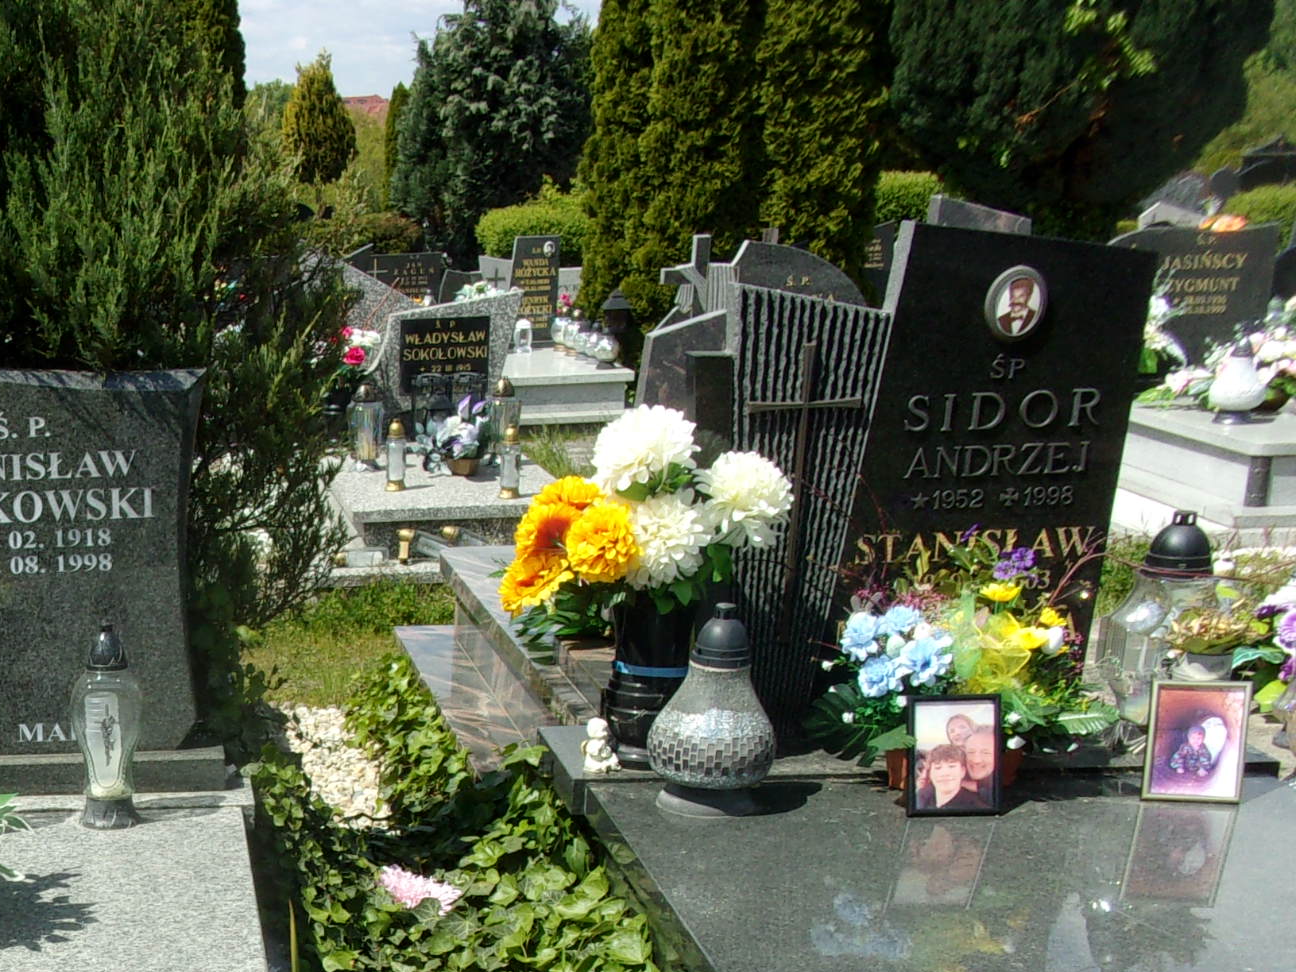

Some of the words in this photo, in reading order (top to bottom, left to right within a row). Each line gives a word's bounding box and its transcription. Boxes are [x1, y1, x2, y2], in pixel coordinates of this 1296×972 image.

[405, 330, 486, 345] WŁADYSŁAW
[403, 346, 488, 361] SOKOŁOWSKI
[990, 353, 1025, 380] ŚP
[904, 387, 1100, 433] SIDOR
[28, 416, 51, 438] P.
[904, 440, 1090, 479] ANDRZEJ
[932, 488, 984, 510] 1952
[1023, 485, 1073, 507] 1998
[8, 530, 44, 549] 02.
[55, 528, 112, 547] 1918
[10, 555, 46, 574] 08.
[56, 552, 113, 573] 1998
